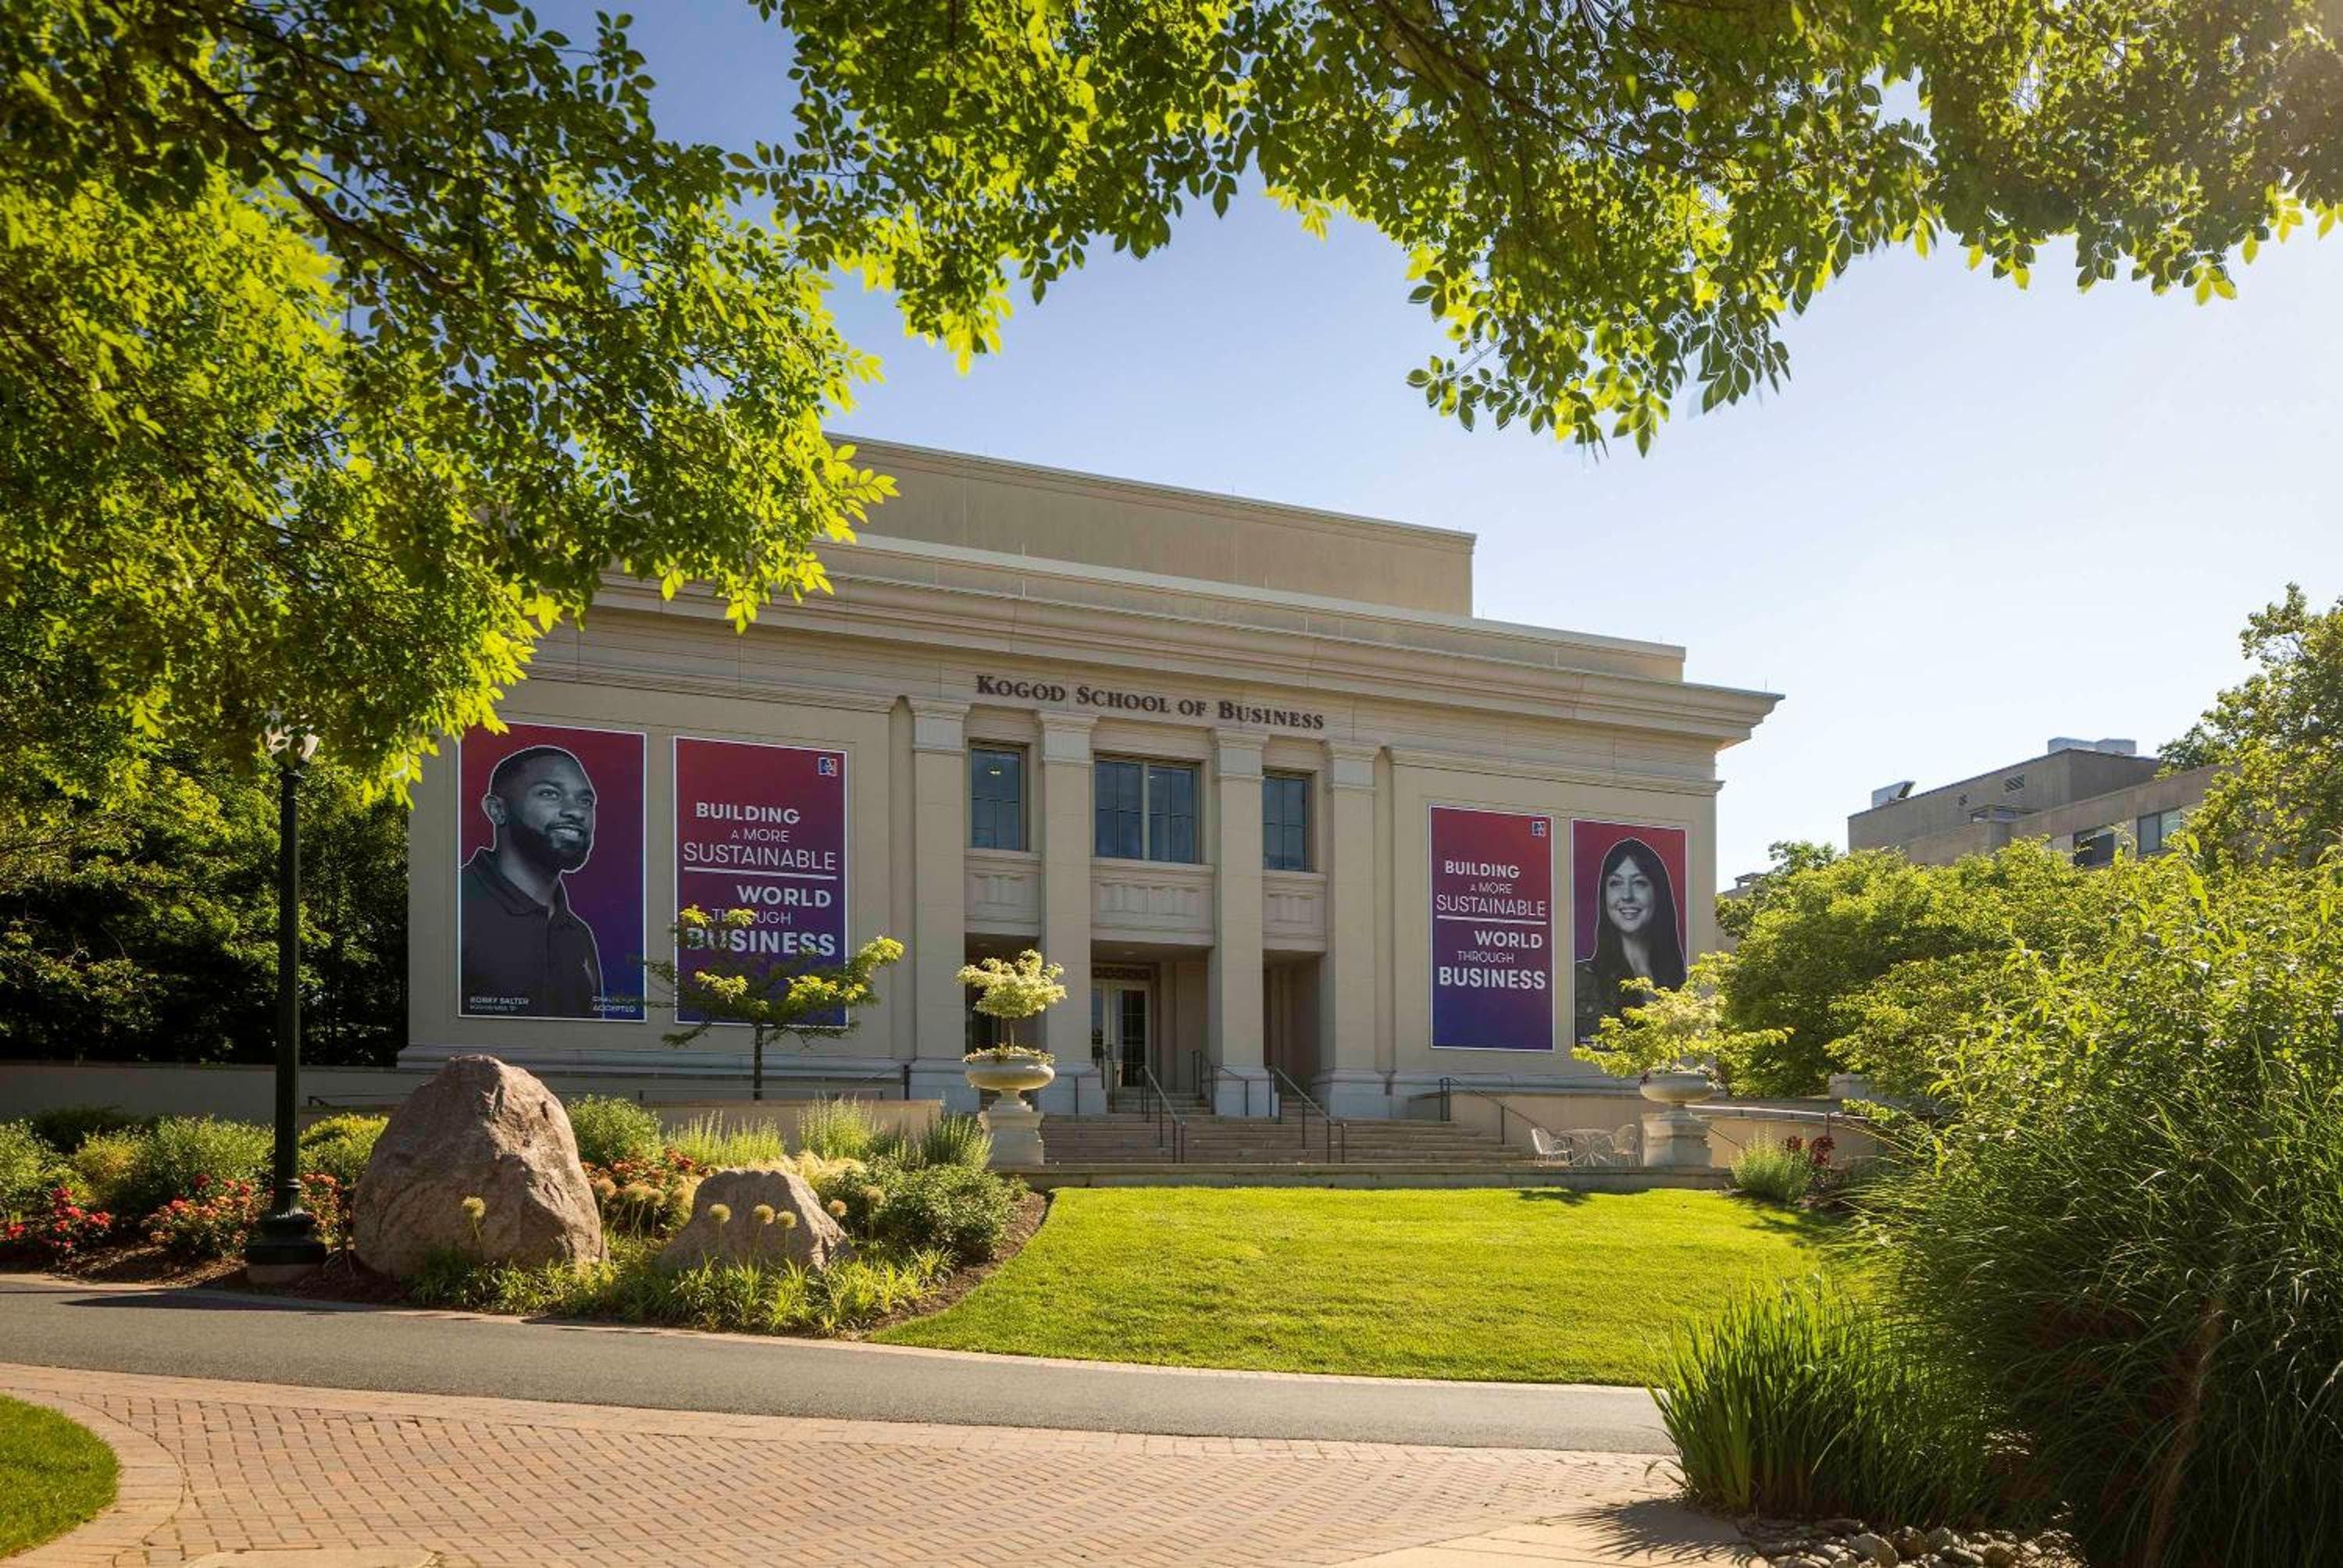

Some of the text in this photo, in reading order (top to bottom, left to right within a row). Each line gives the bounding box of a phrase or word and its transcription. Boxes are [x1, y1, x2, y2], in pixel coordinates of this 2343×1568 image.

[696, 803, 801, 824] BUILDING
[730, 829, 790, 843] A MORE
[683, 843, 836, 871] SUSTAINABLE
[1445, 861, 1521, 878] BUILDING
[736, 885, 832, 907] WORLD
[1478, 882, 1513, 894] MORE
[1436, 894, 1546, 917] SUSTAINABLE
[1474, 930, 1543, 949] WORLD
[1457, 950, 1514, 964] THROUGH
[1439, 967, 1546, 989] BUSINESS
